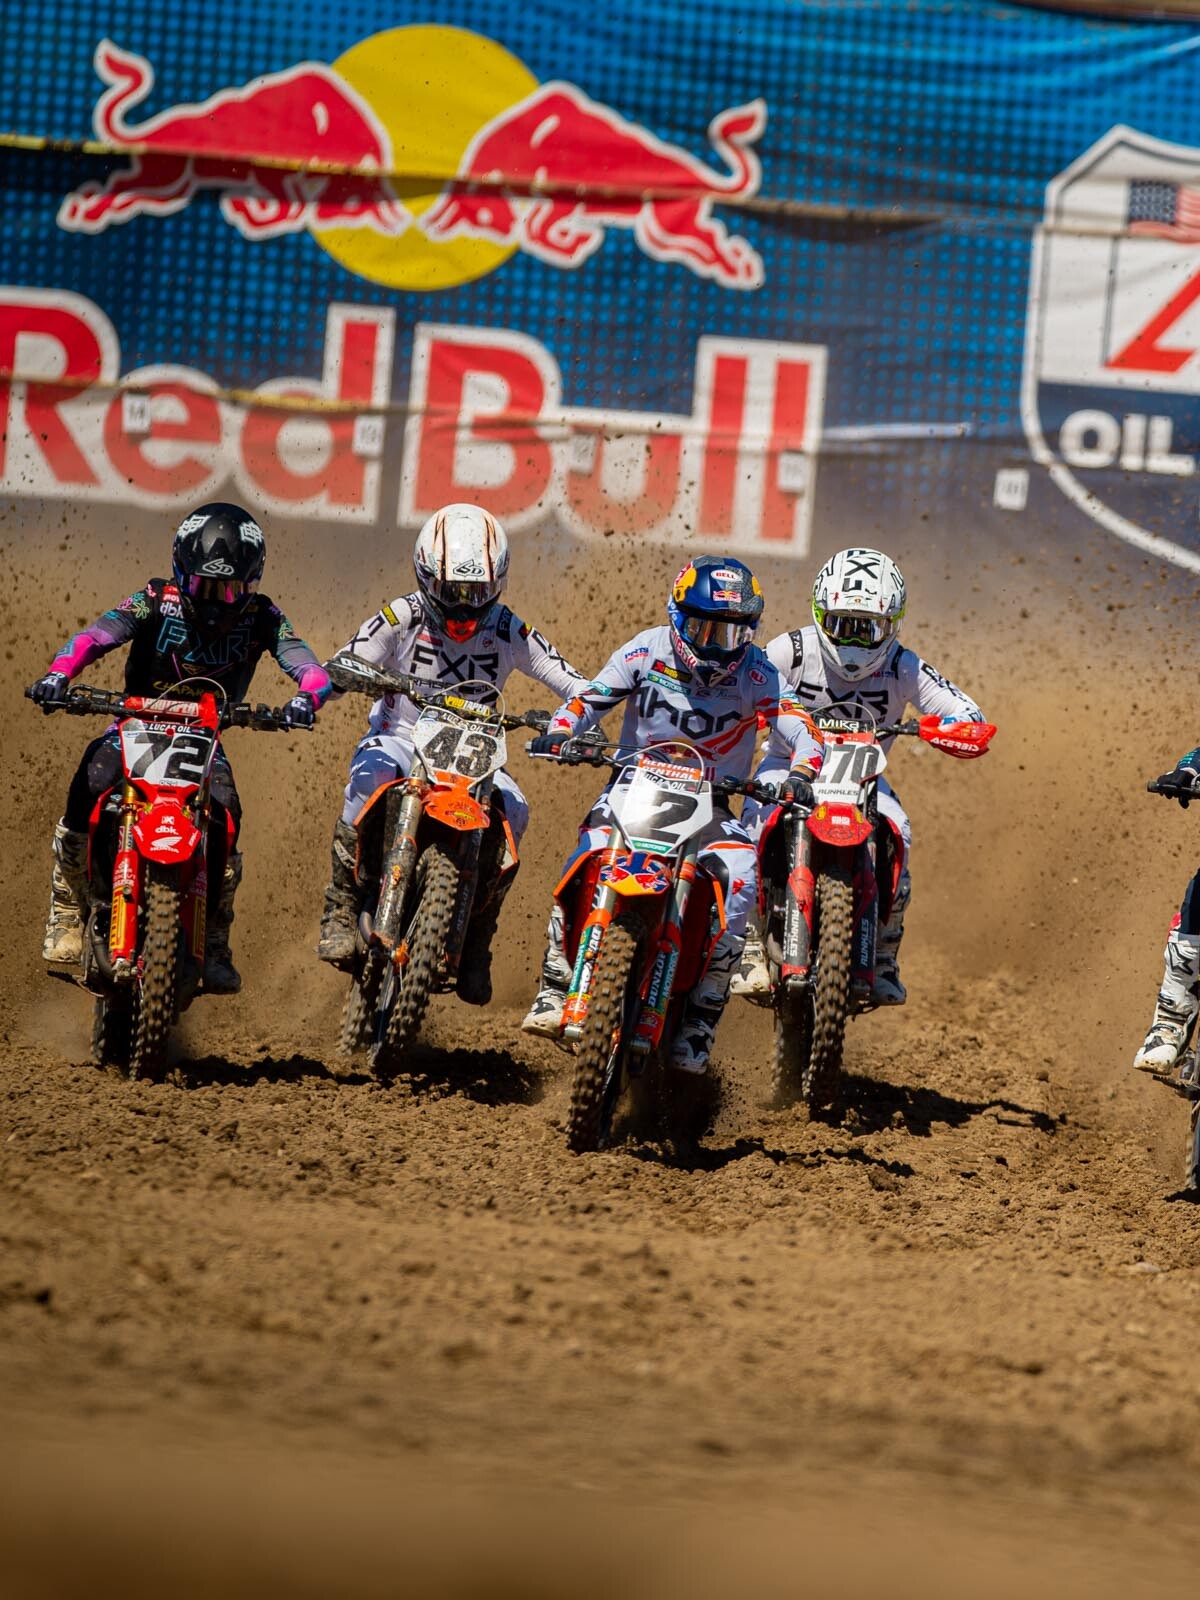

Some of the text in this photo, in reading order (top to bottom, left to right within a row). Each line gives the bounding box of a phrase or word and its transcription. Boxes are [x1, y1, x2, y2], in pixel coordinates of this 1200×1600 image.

[0, 293, 823, 552] Red Bull
[1058, 408, 1197, 476] OIL
[715, 571, 736, 580] BELL
[410, 644, 499, 686] FXR
[148, 723, 192, 733] LUCAS OIL
[929, 736, 980, 752] ACERBIS
[131, 732, 212, 782] 72
[422, 726, 497, 779] 43
[642, 758, 697, 773] RENTHAL
[671, 781, 686, 790] OIL
[817, 788, 860, 797] RUNKLES
[790, 908, 800, 958] RUNKLES
[859, 918, 870, 968] RUNKLES
[648, 951, 666, 1007] DUNLOP
